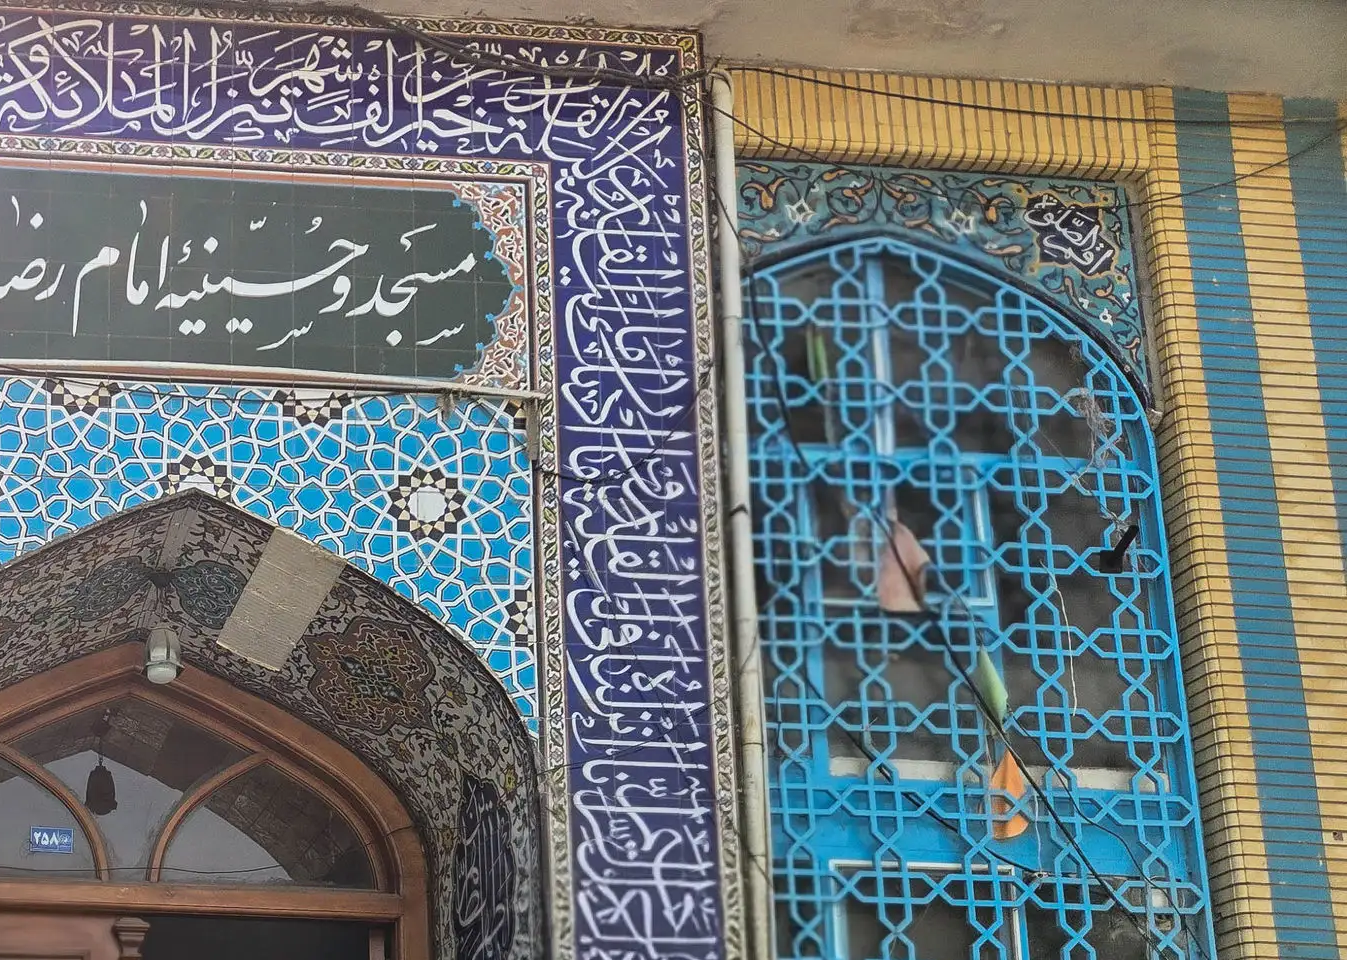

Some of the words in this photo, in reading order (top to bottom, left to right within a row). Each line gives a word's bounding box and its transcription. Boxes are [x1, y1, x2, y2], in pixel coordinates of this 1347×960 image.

[72, 230, 169, 336] امام
[319, 274, 352, 314] و
[347, 247, 475, 345] مسجد
[33, 831, 59, 846] ۲۵۸
